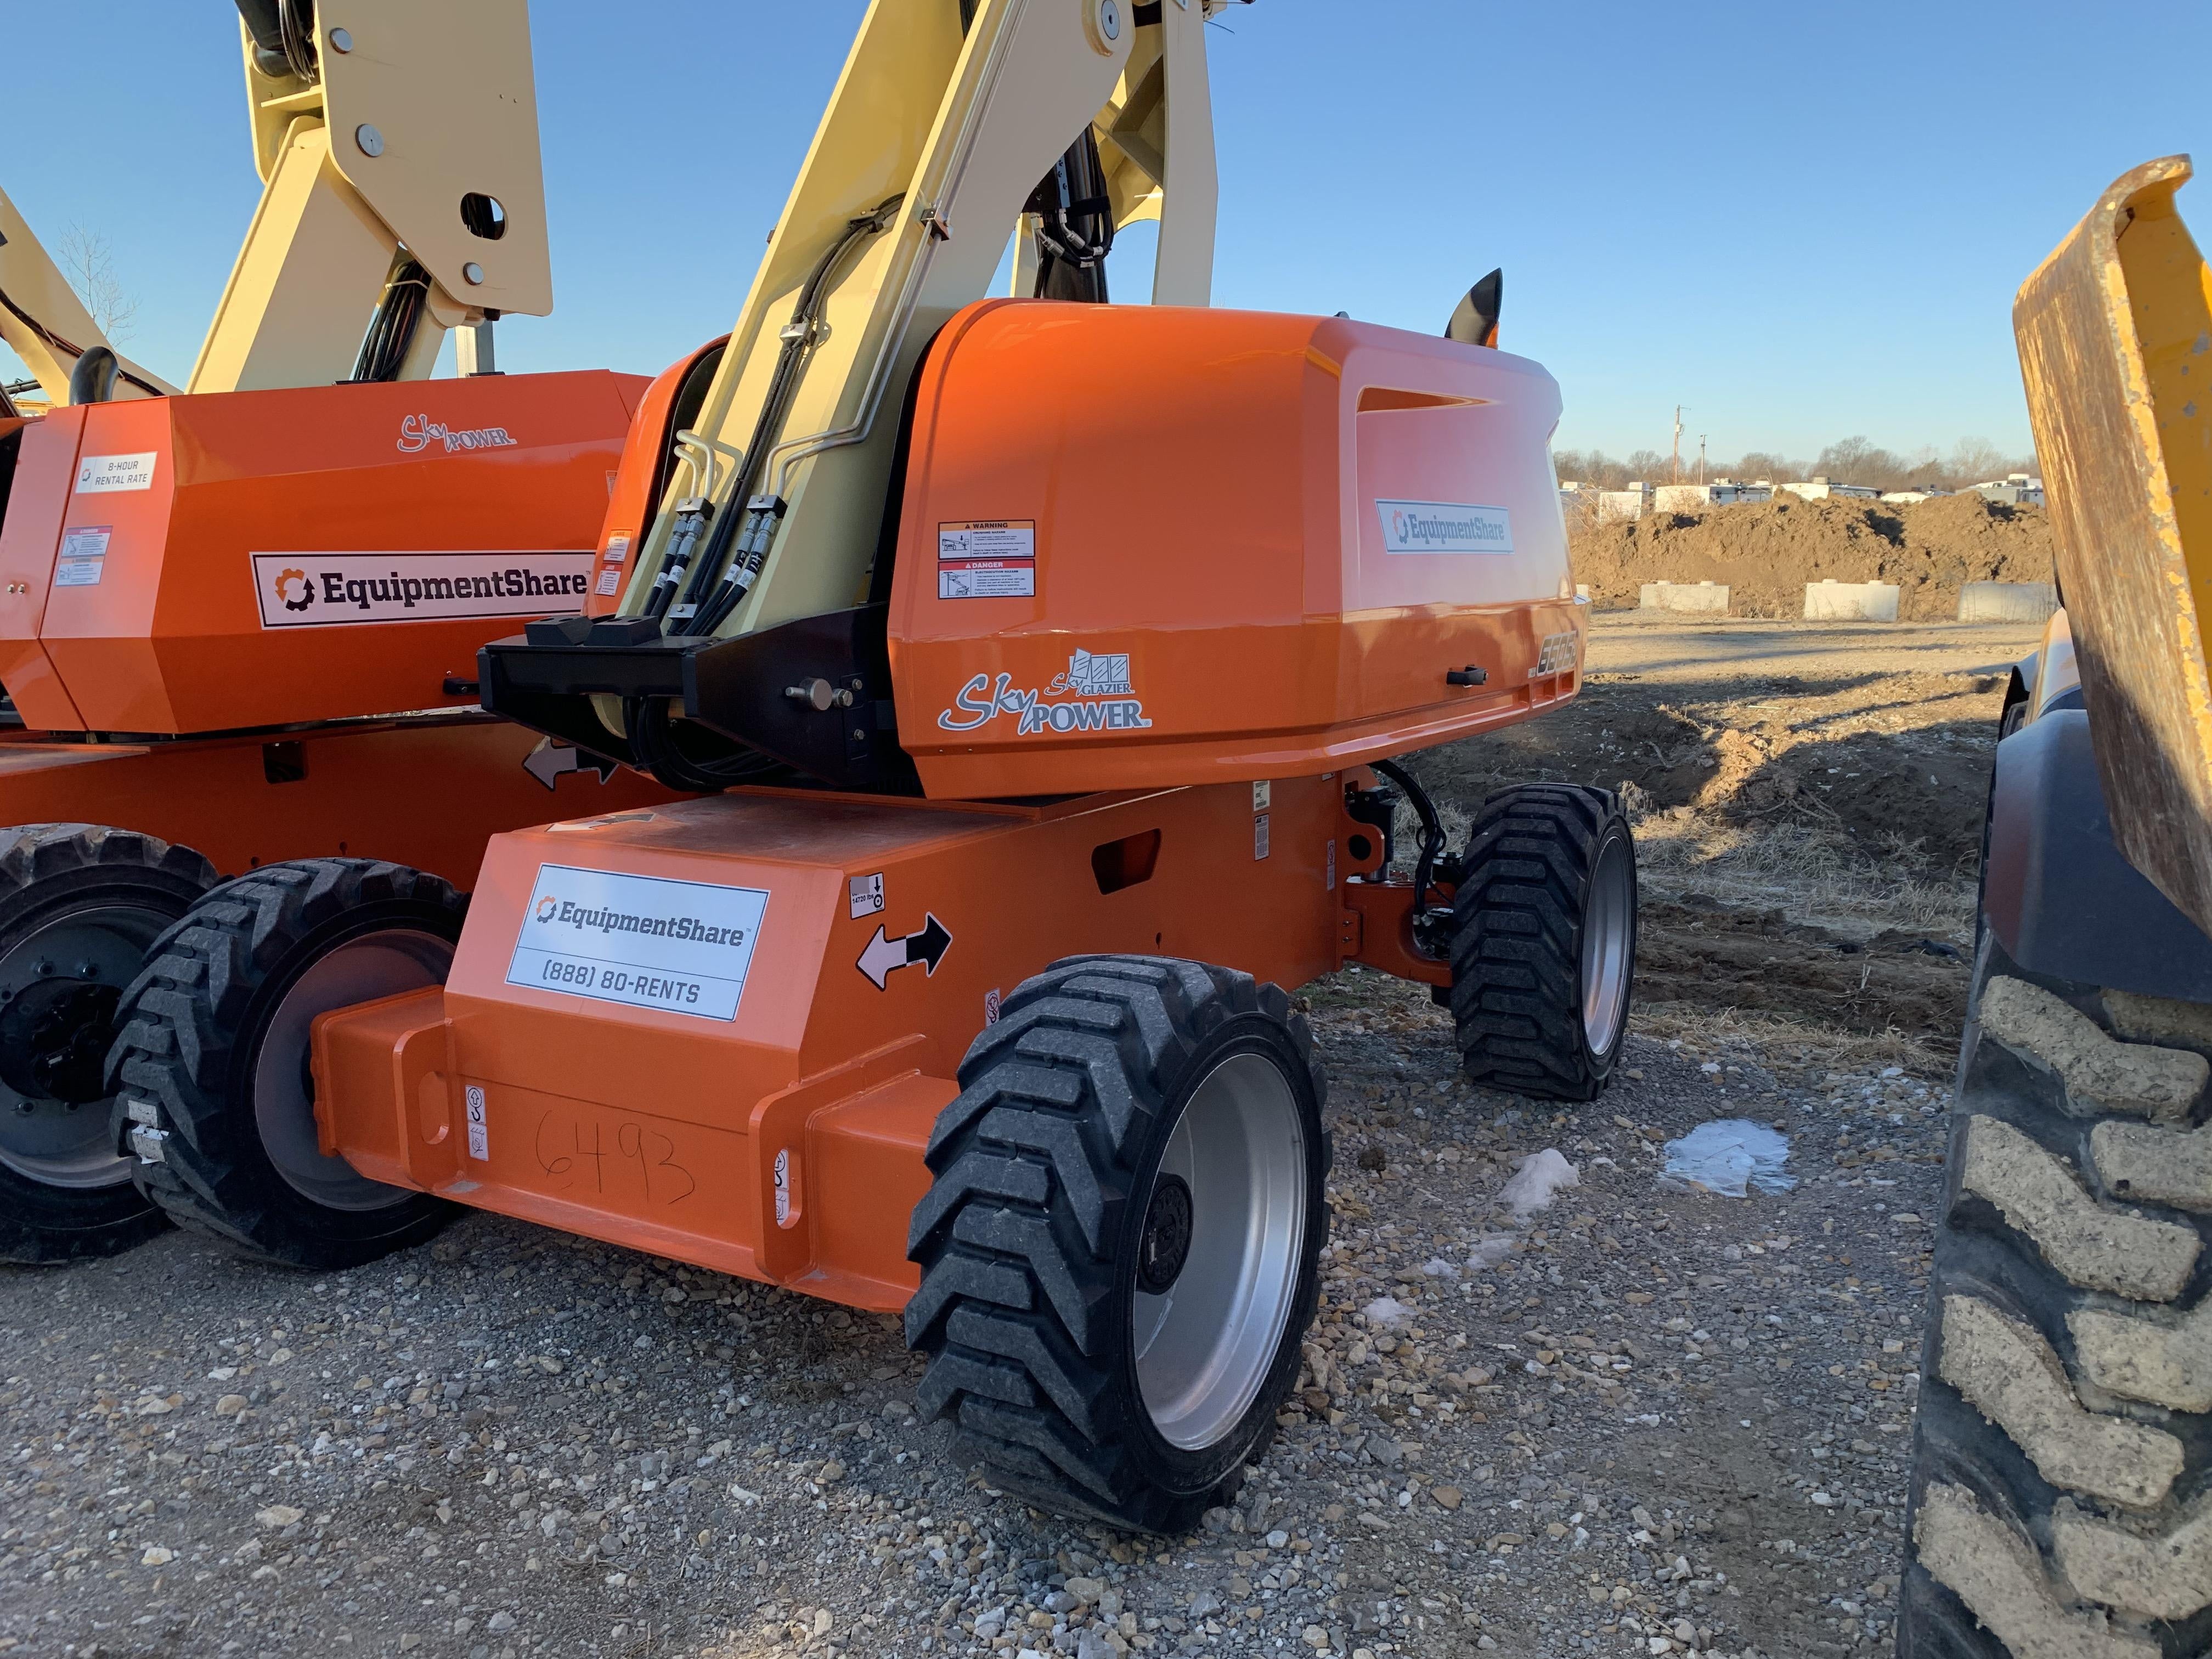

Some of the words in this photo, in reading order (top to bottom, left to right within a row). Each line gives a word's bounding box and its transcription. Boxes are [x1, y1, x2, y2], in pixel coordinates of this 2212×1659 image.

[95, 476, 125, 486] RENTAL
[127, 473, 148, 483] RATE
[108, 461, 139, 471] 8-HOUR
[1407, 514, 1505, 545] EquipmentShare
[320, 569, 588, 610] EquipmentShare
[852, 895, 866, 904] 14720
[558, 901, 744, 947] EquipmentShare
[542, 959, 596, 988] (888)
[601, 970, 701, 1003] 80-RENTS
[536, 1109, 695, 1205] 6493
